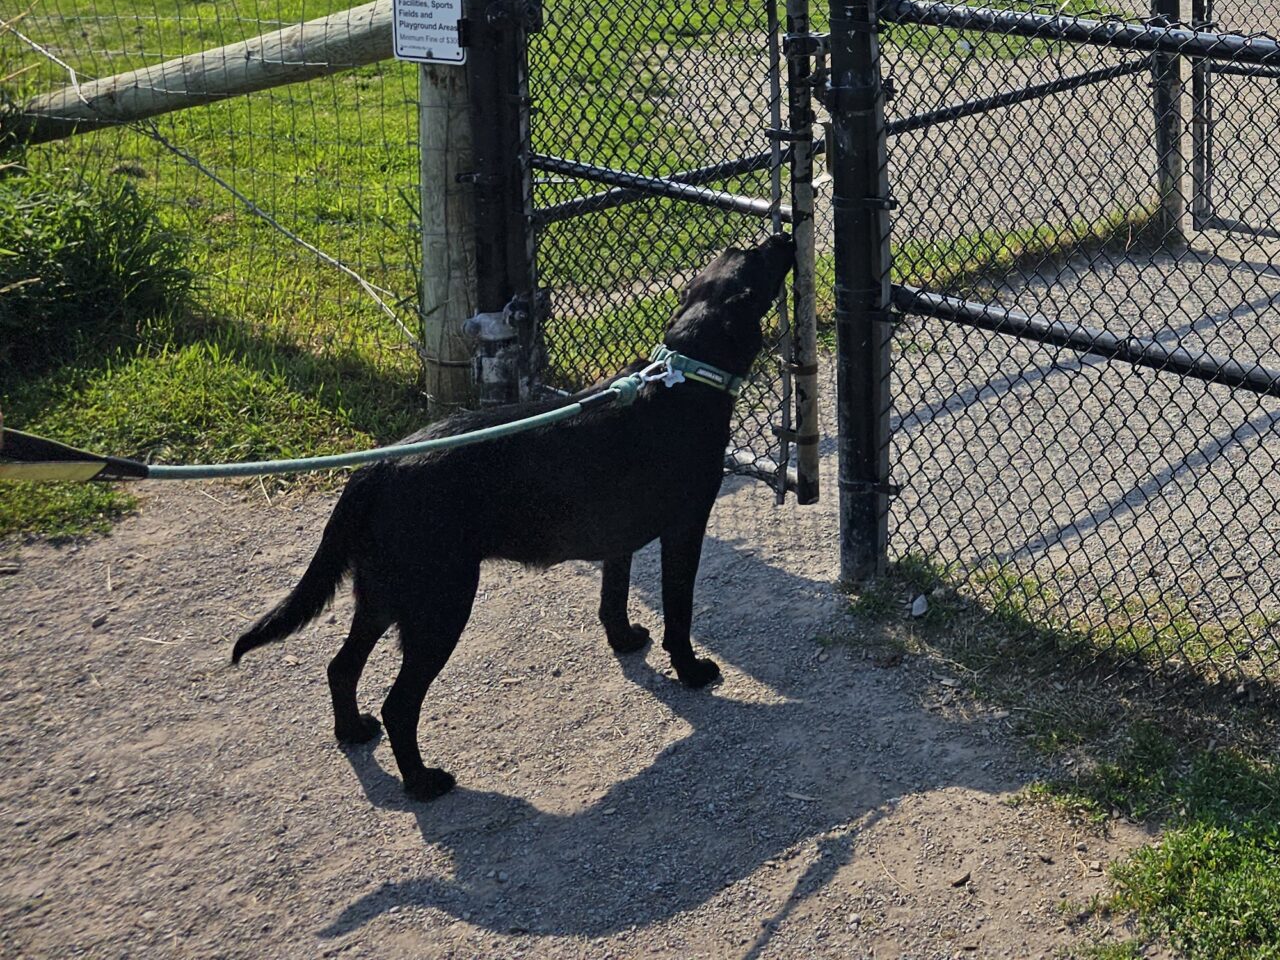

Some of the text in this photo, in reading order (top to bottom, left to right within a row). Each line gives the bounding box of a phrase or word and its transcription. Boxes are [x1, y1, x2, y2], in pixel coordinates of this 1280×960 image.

[431, 0, 454, 10] Sports
[399, 9, 433, 19] Fields and
[399, 20, 437, 31] Playground
